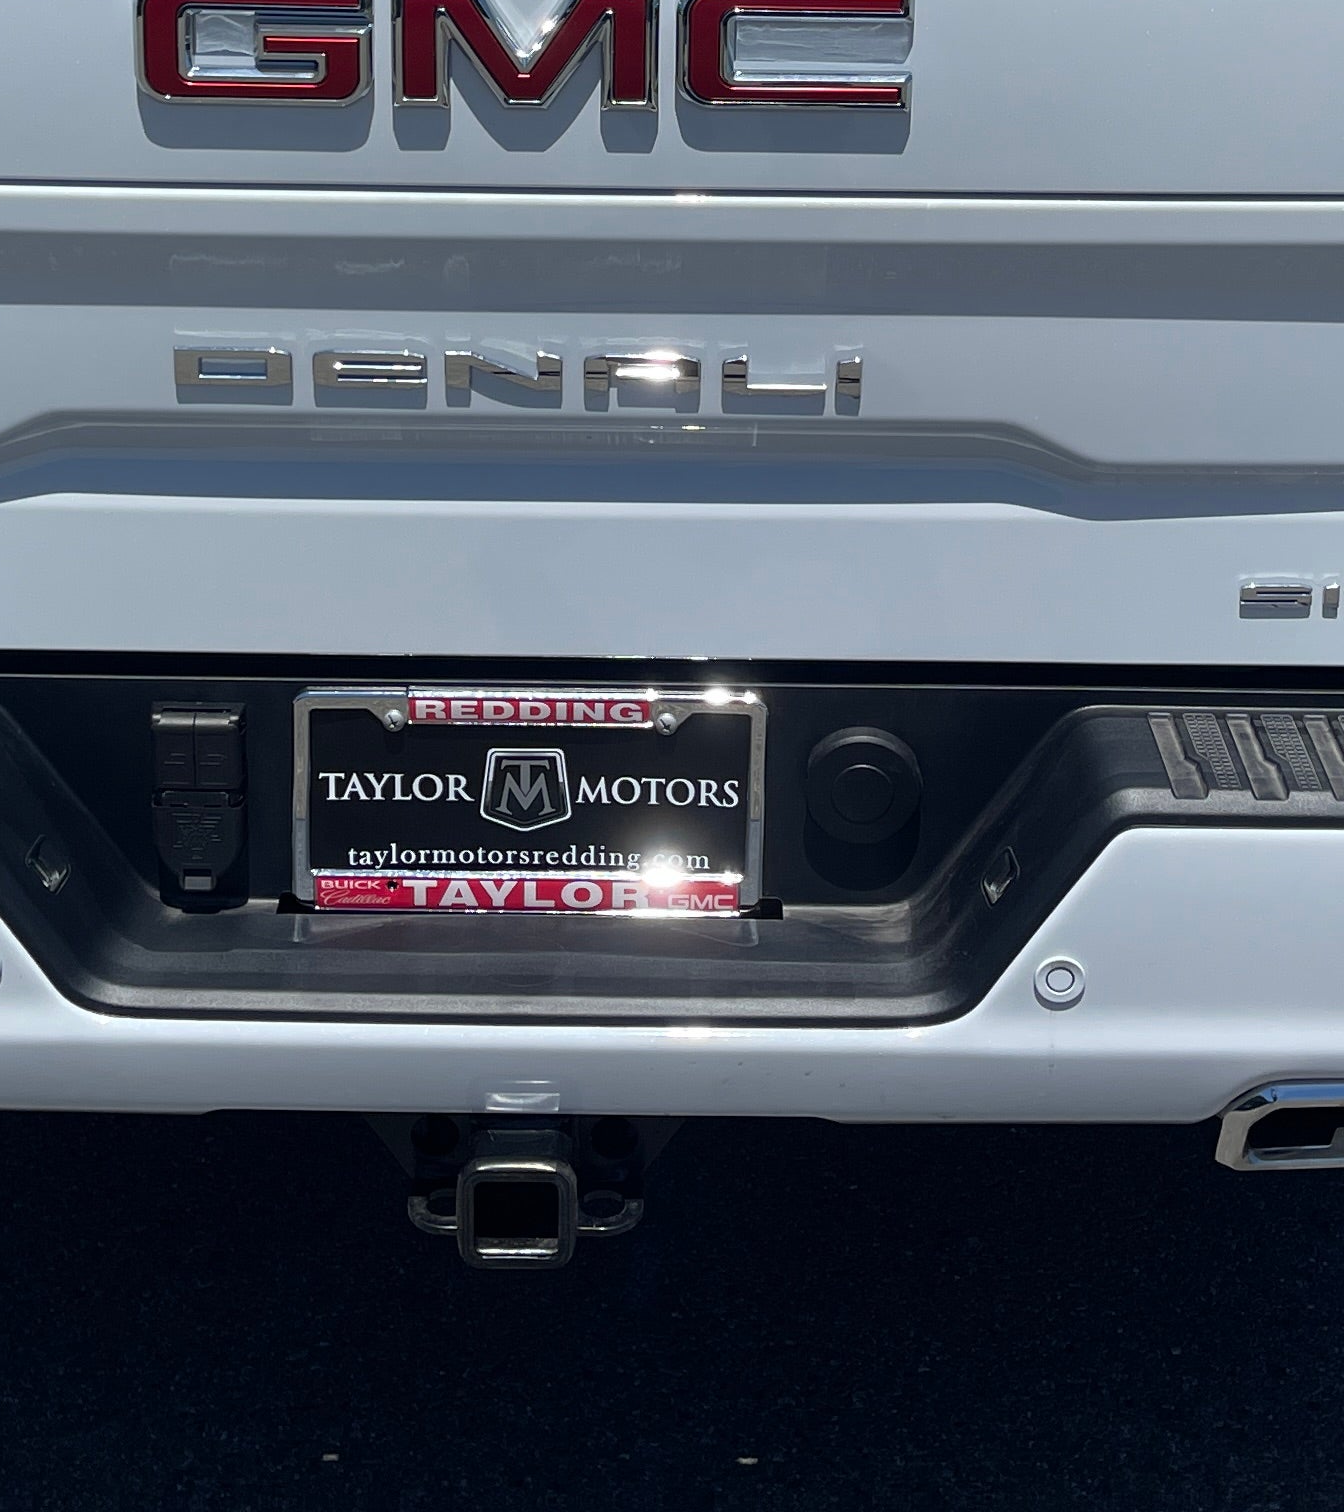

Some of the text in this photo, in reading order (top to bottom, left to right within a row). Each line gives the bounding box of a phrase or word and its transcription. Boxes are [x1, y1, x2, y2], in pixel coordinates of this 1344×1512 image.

[172, 344, 864, 400] DENALI
[414, 699, 646, 723] REDDING
[318, 771, 740, 809] TAYLOR MOTORS
[347, 842, 711, 872] taylormotorsredding.com
[319, 889, 392, 907] Cadillac
[320, 879, 381, 890] BUICK
[402, 878, 650, 910] TAYLOR
[667, 893, 734, 911] GMC
